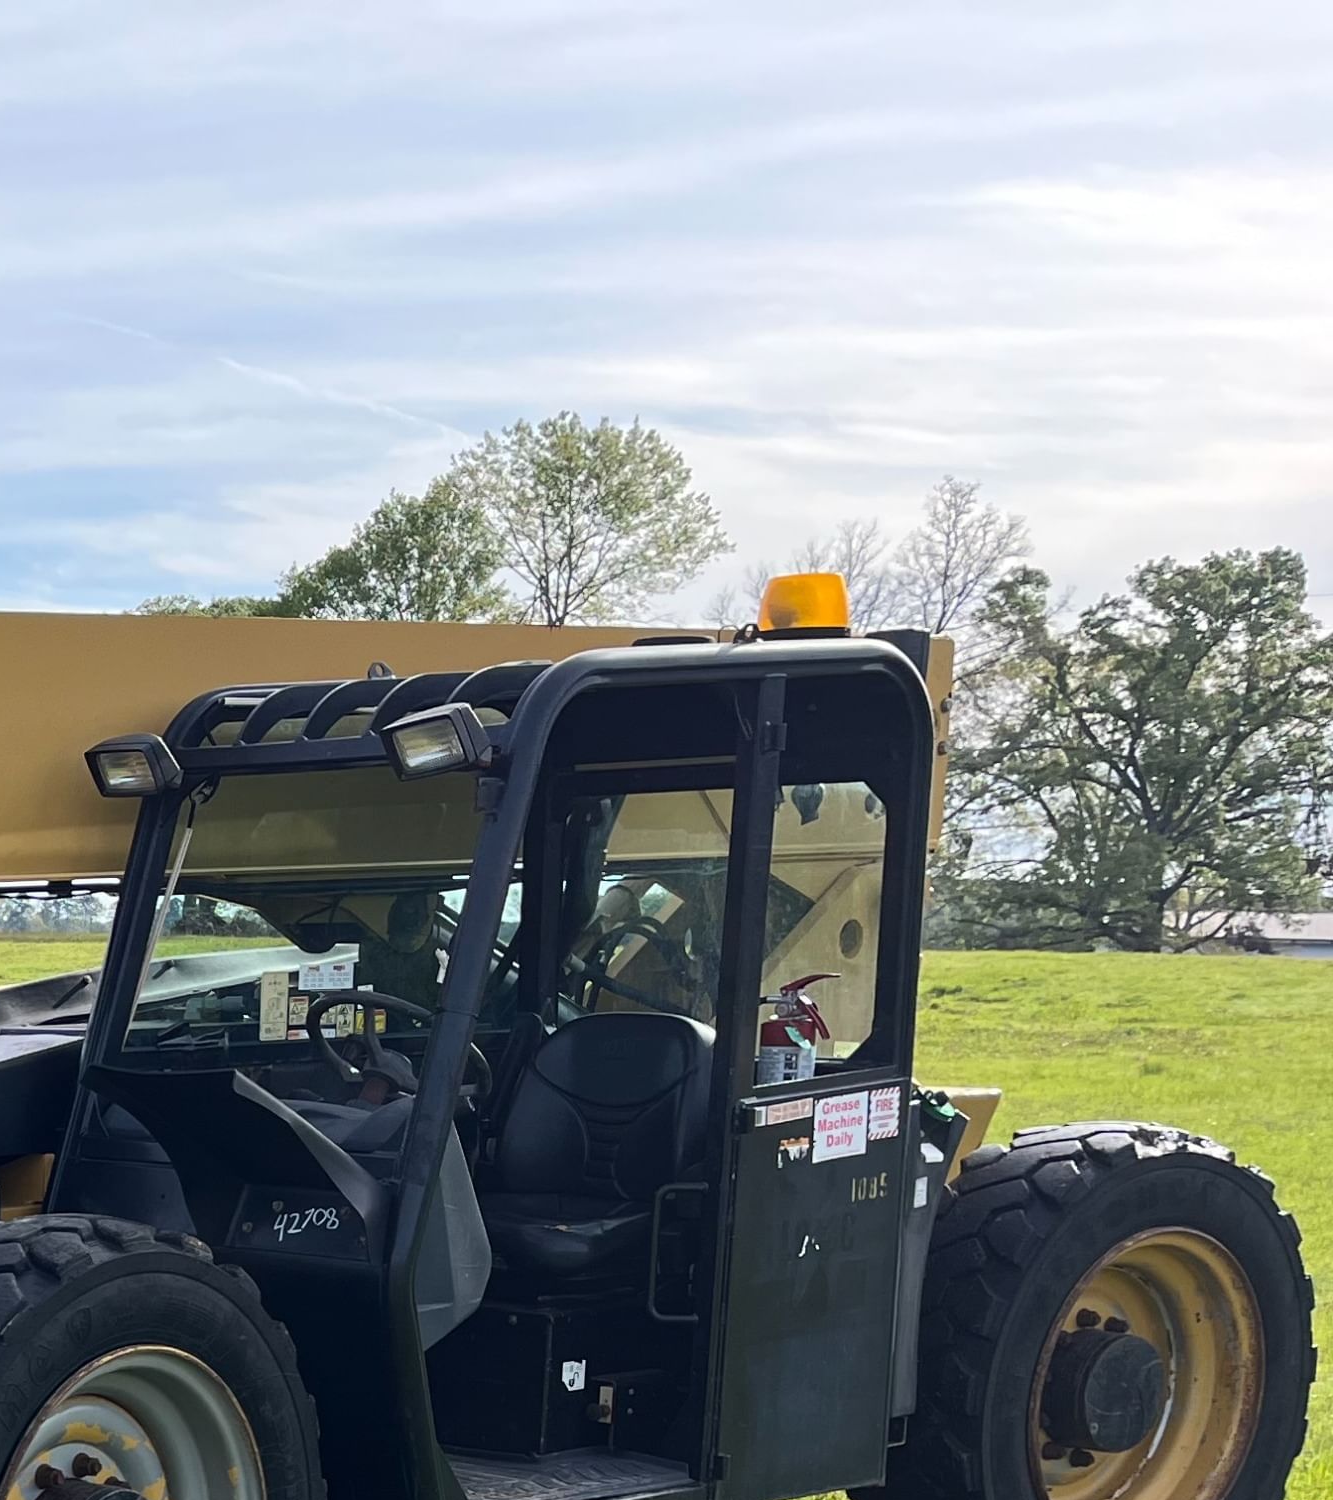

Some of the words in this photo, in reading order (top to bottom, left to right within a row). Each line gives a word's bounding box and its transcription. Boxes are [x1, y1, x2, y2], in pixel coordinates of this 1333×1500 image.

[822, 1098, 860, 1115] Grease
[875, 1097, 894, 1113] FIRE
[817, 1114, 863, 1132] Machine
[826, 1132, 854, 1148] Daily
[273, 1207, 340, 1242] 42708
